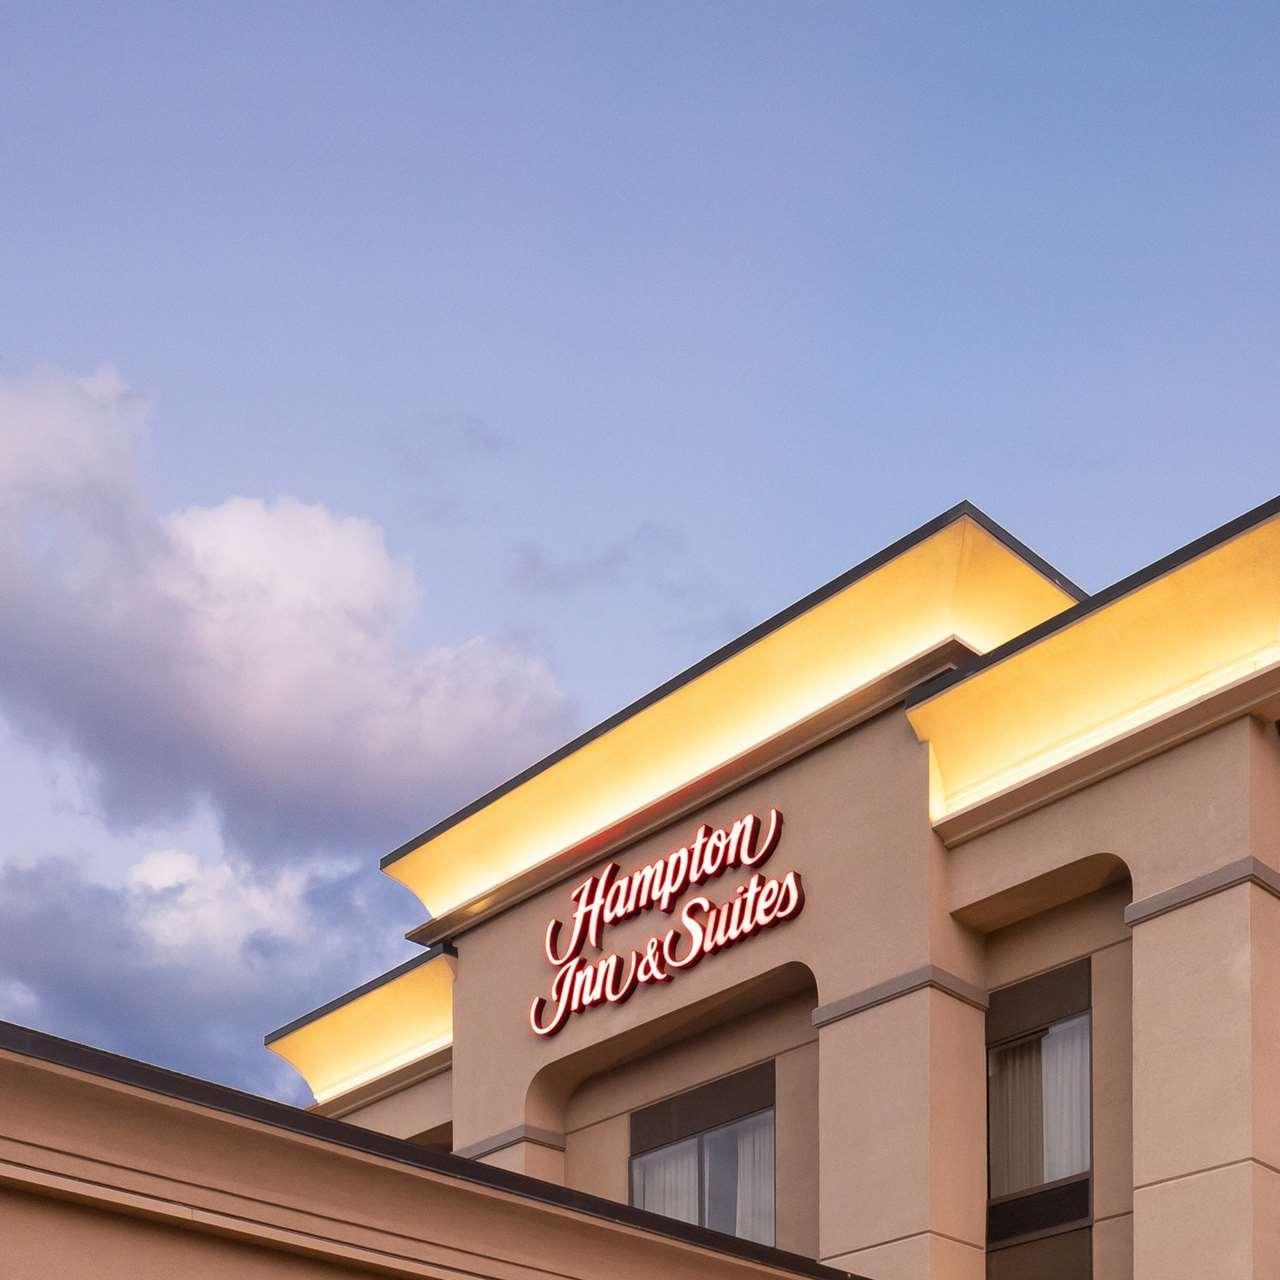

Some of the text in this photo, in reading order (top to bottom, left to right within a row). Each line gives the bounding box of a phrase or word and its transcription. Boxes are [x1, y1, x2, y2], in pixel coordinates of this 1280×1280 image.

[530, 871, 805, 1036] Inn & Suites
[546, 808, 783, 966] Hampton
